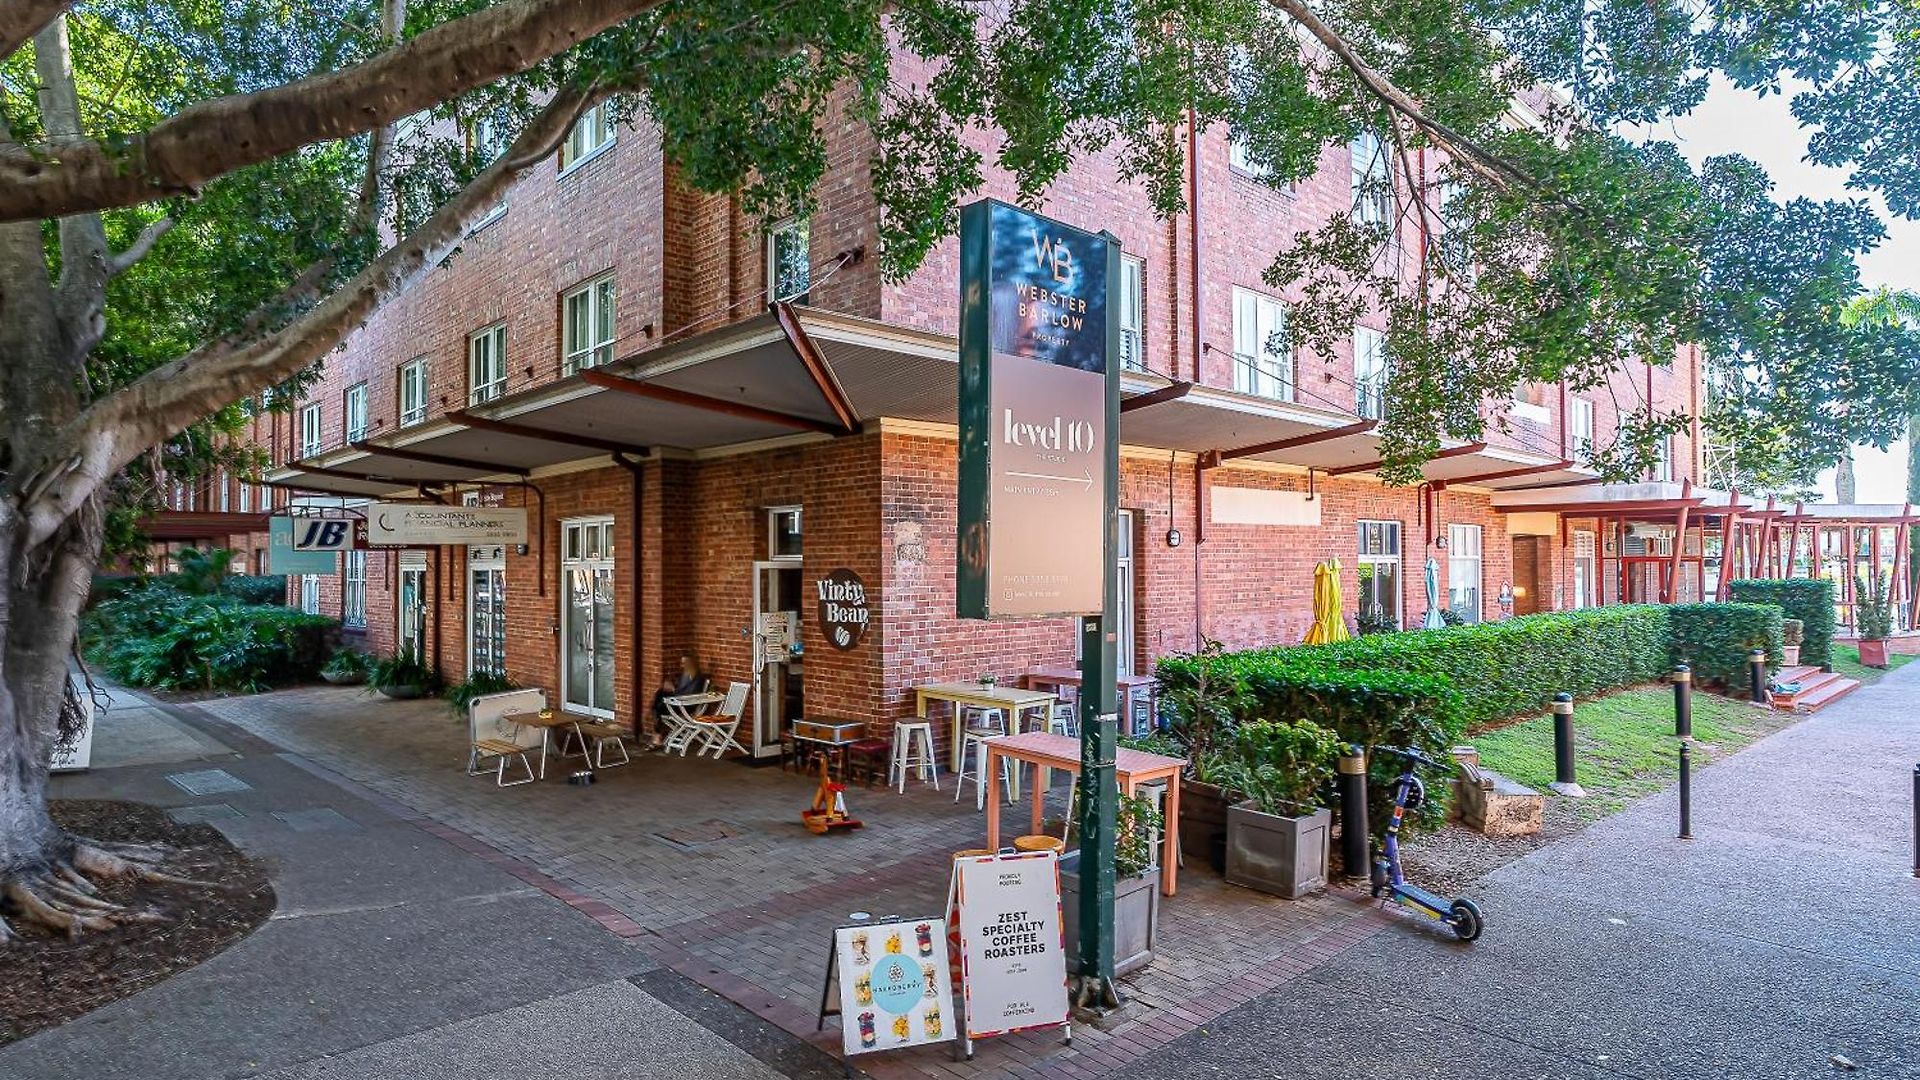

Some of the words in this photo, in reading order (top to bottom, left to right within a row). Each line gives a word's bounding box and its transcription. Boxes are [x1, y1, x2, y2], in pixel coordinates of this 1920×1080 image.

[1016, 282, 1087, 315] WEBSTER
[1019, 303, 1084, 331] BARLOW
[1004, 409, 1061, 450] level
[1068, 420, 1094, 454] 10
[404, 520, 454, 528] FIANCIAL
[458, 520, 504, 528] PLANNERS
[296, 521, 349, 548] JB
[826, 602, 869, 625] Bean
[998, 911, 1028, 924] ZEST
[982, 920, 1045, 937] SPECIALTY
[992, 933, 1037, 947] COFFEE
[984, 943, 1046, 960] ROASTERS
